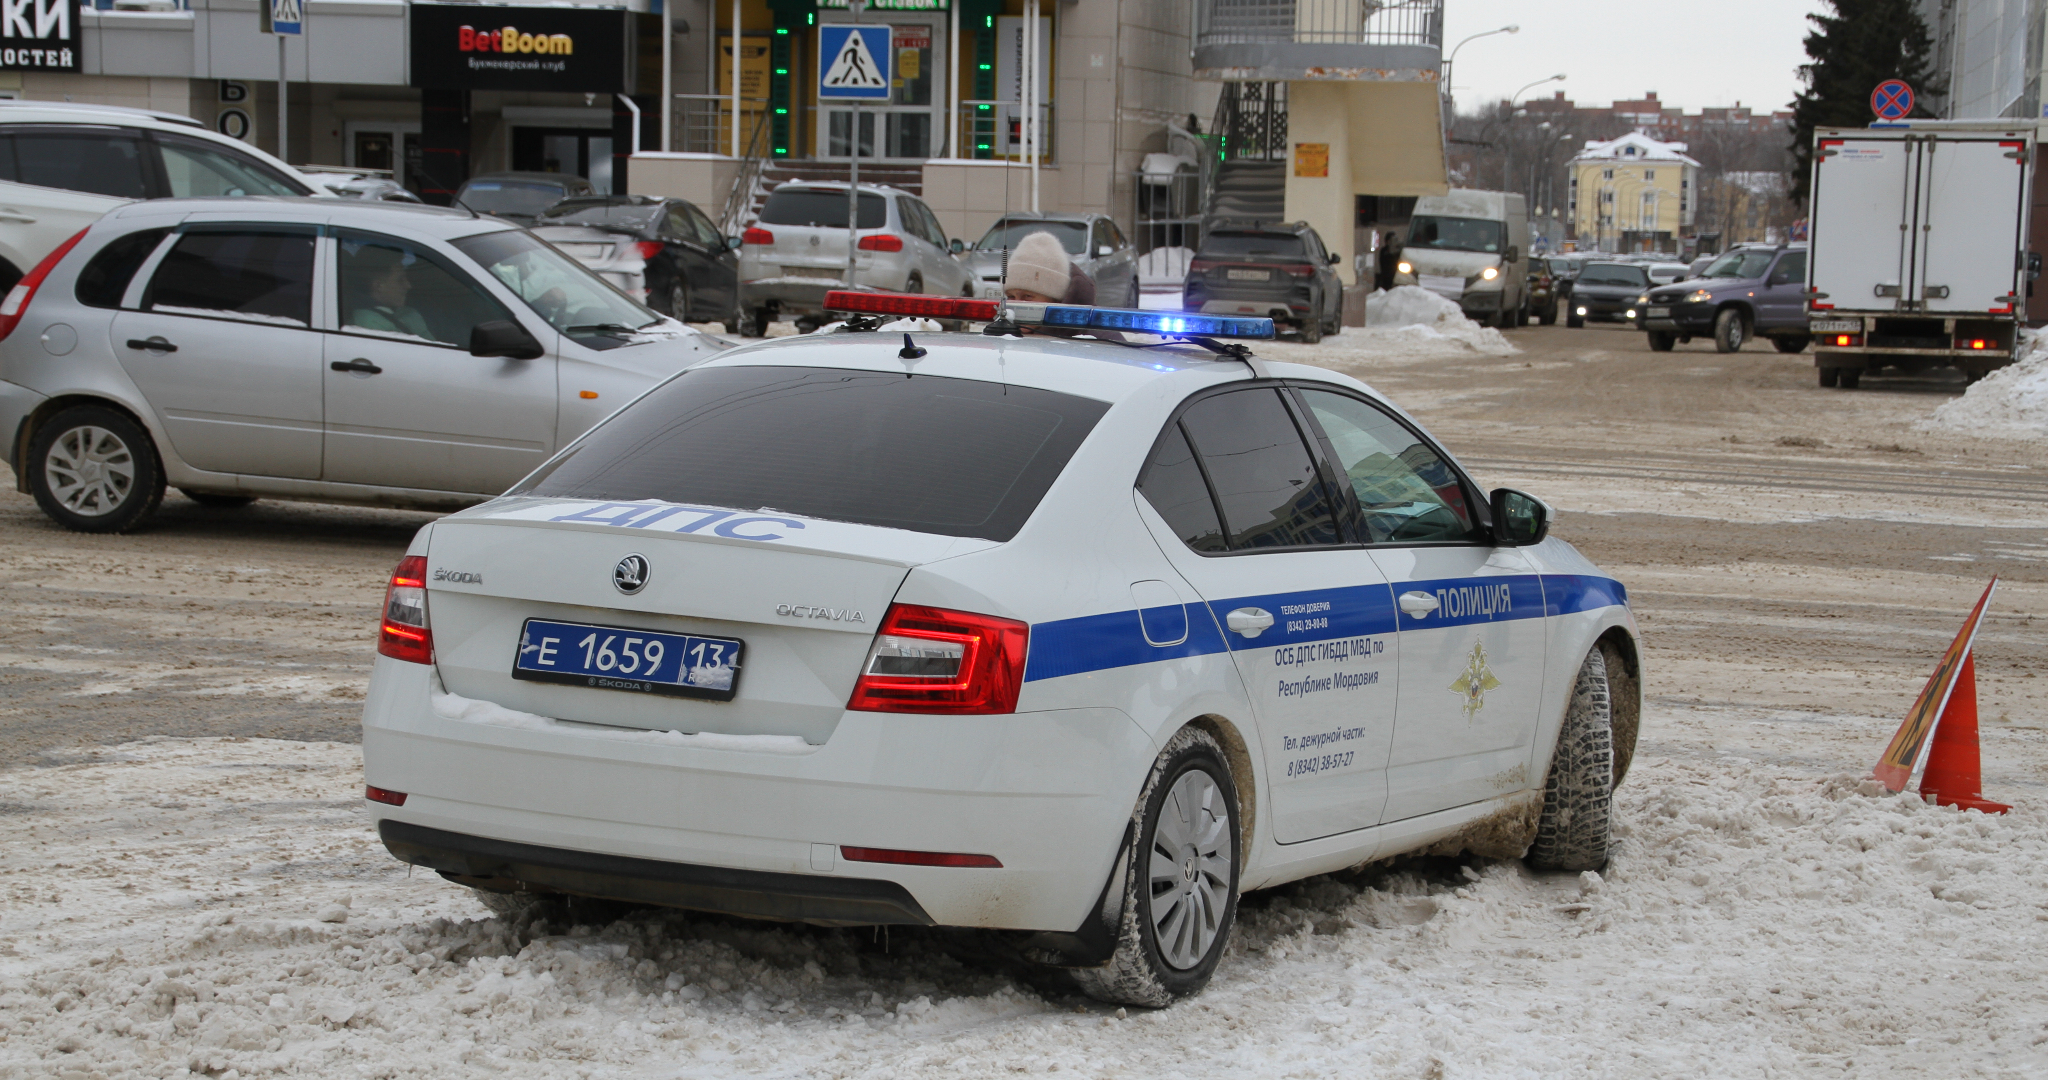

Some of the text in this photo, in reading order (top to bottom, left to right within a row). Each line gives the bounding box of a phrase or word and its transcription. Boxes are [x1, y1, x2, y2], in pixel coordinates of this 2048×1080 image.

[458, 25, 573, 55] BetBoom
[0, 47, 73, 67] ОСТЕЙ
[468, 57, 566, 72] Букмекерский клуб
[548, 503, 806, 541] ДПС
[433, 566, 483, 585] ŠKODA
[776, 603, 866, 624] OCTAVIA
[1281, 601, 1331, 615] ТЕЛЕФОН ДОВЕРИЯ
[1436, 583, 1512, 620] ПОЛИЦИЯ
[1286, 619, 1305, 634] (8342)
[537, 633, 724, 676] Е 1659 13
[1275, 638, 1384, 668] ОСБ ДПС ГИБДД МВД по
[599, 678, 641, 690] ŠKODA
[1278, 671, 1379, 698] Республике Мордовия
[1283, 726, 1366, 751] Тел. дежурной части:
[1287, 751, 1354, 778] 8 (8342) 38-57-27
